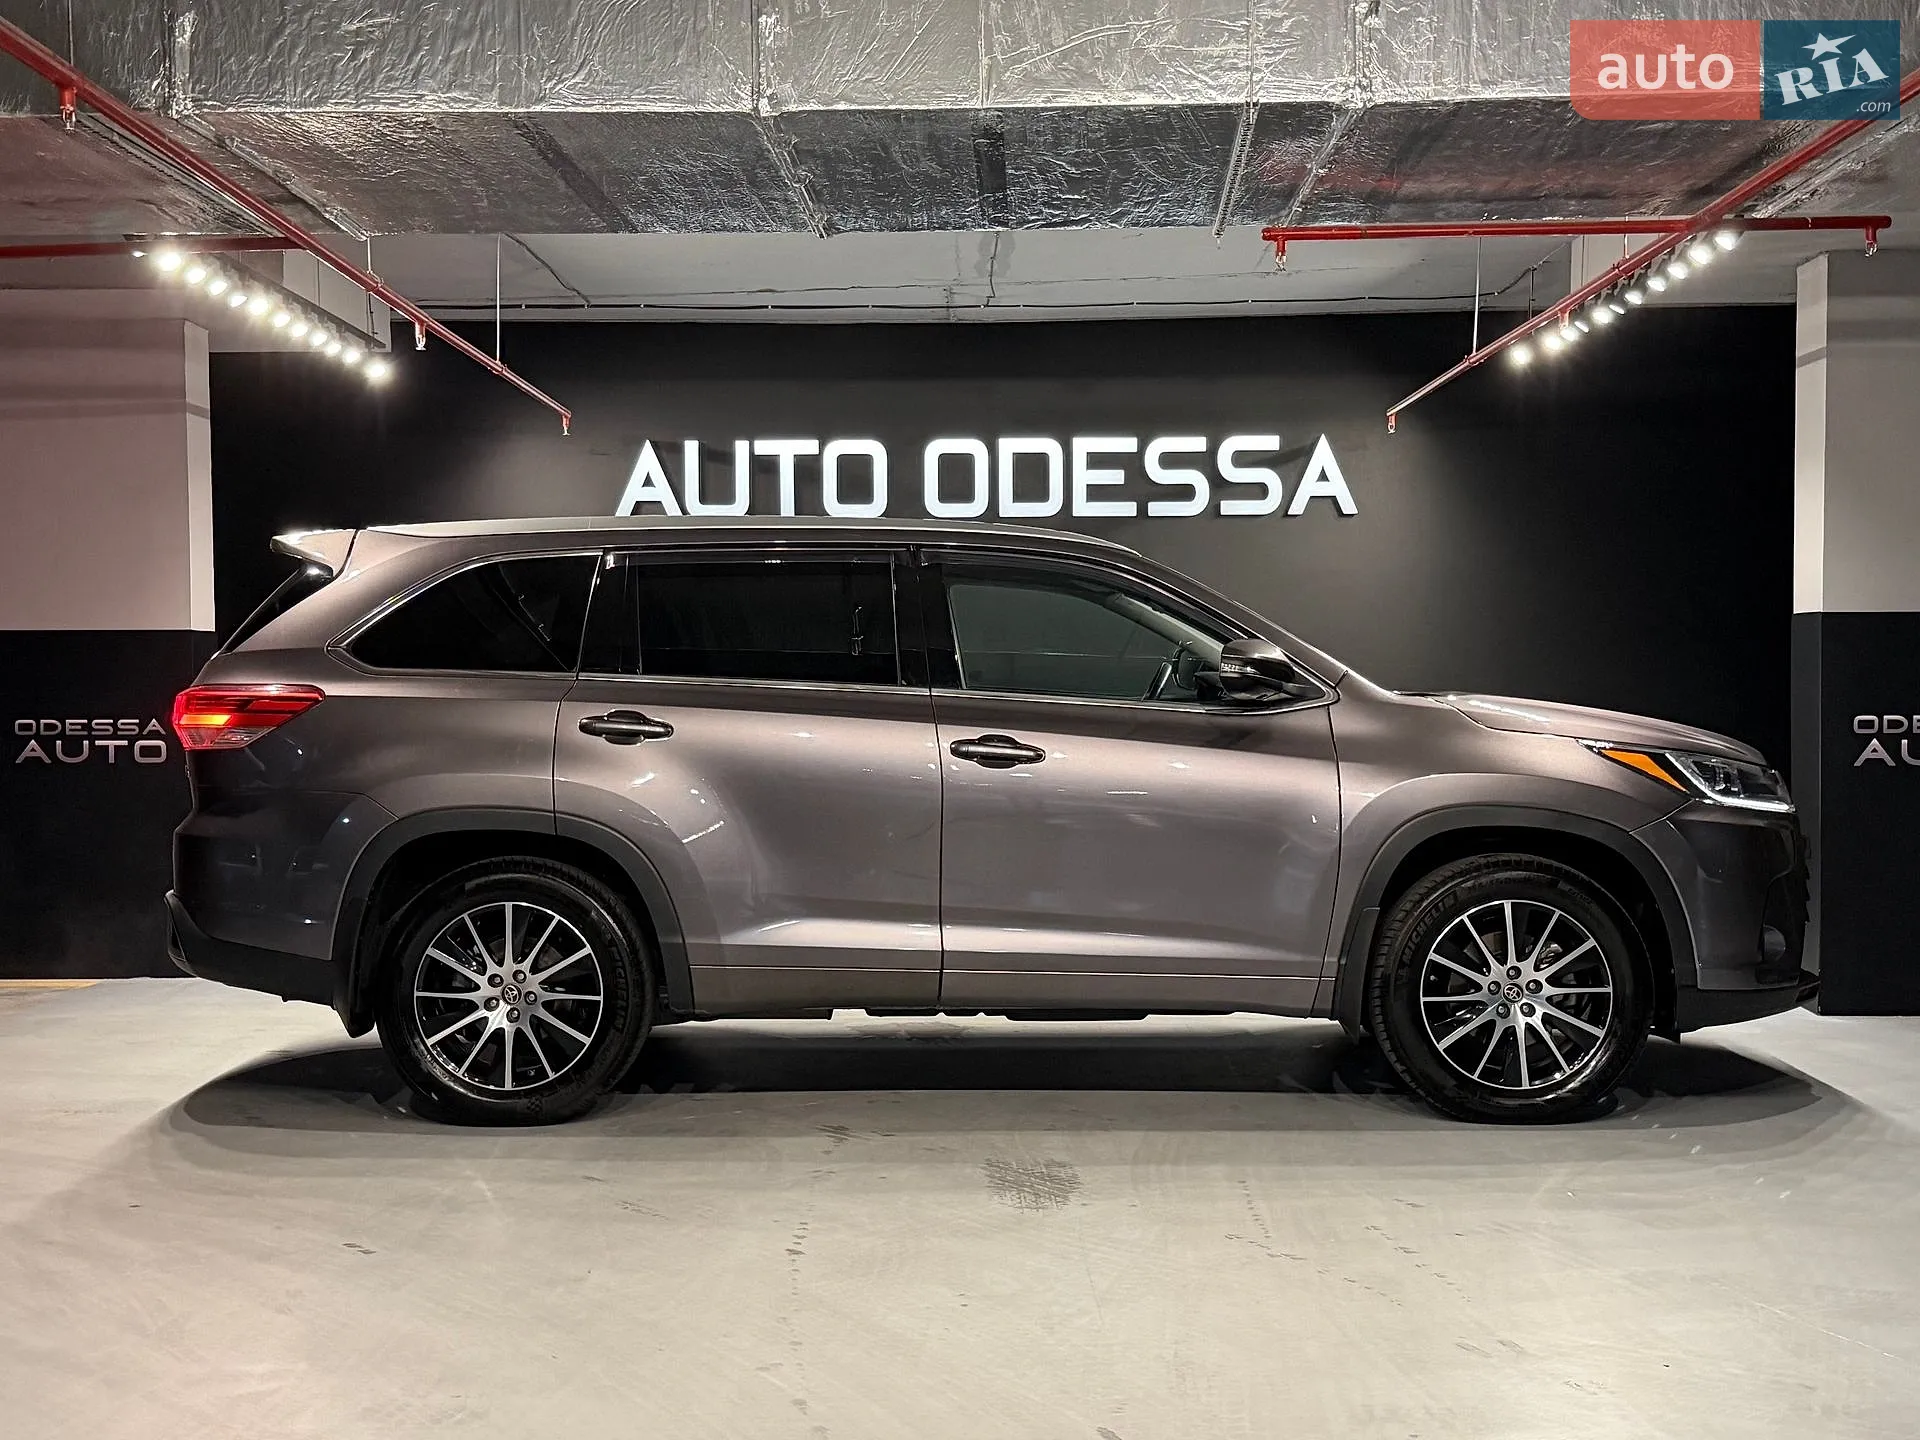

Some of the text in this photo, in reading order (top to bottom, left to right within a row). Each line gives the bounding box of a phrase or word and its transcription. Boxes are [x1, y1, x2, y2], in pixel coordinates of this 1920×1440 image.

[614, 433, 1359, 518] AUTO ODESSA
[14, 718, 167, 736] ODESSA
[15, 739, 167, 764] AUTO
[1402, 893, 1457, 966] MICHELIN
